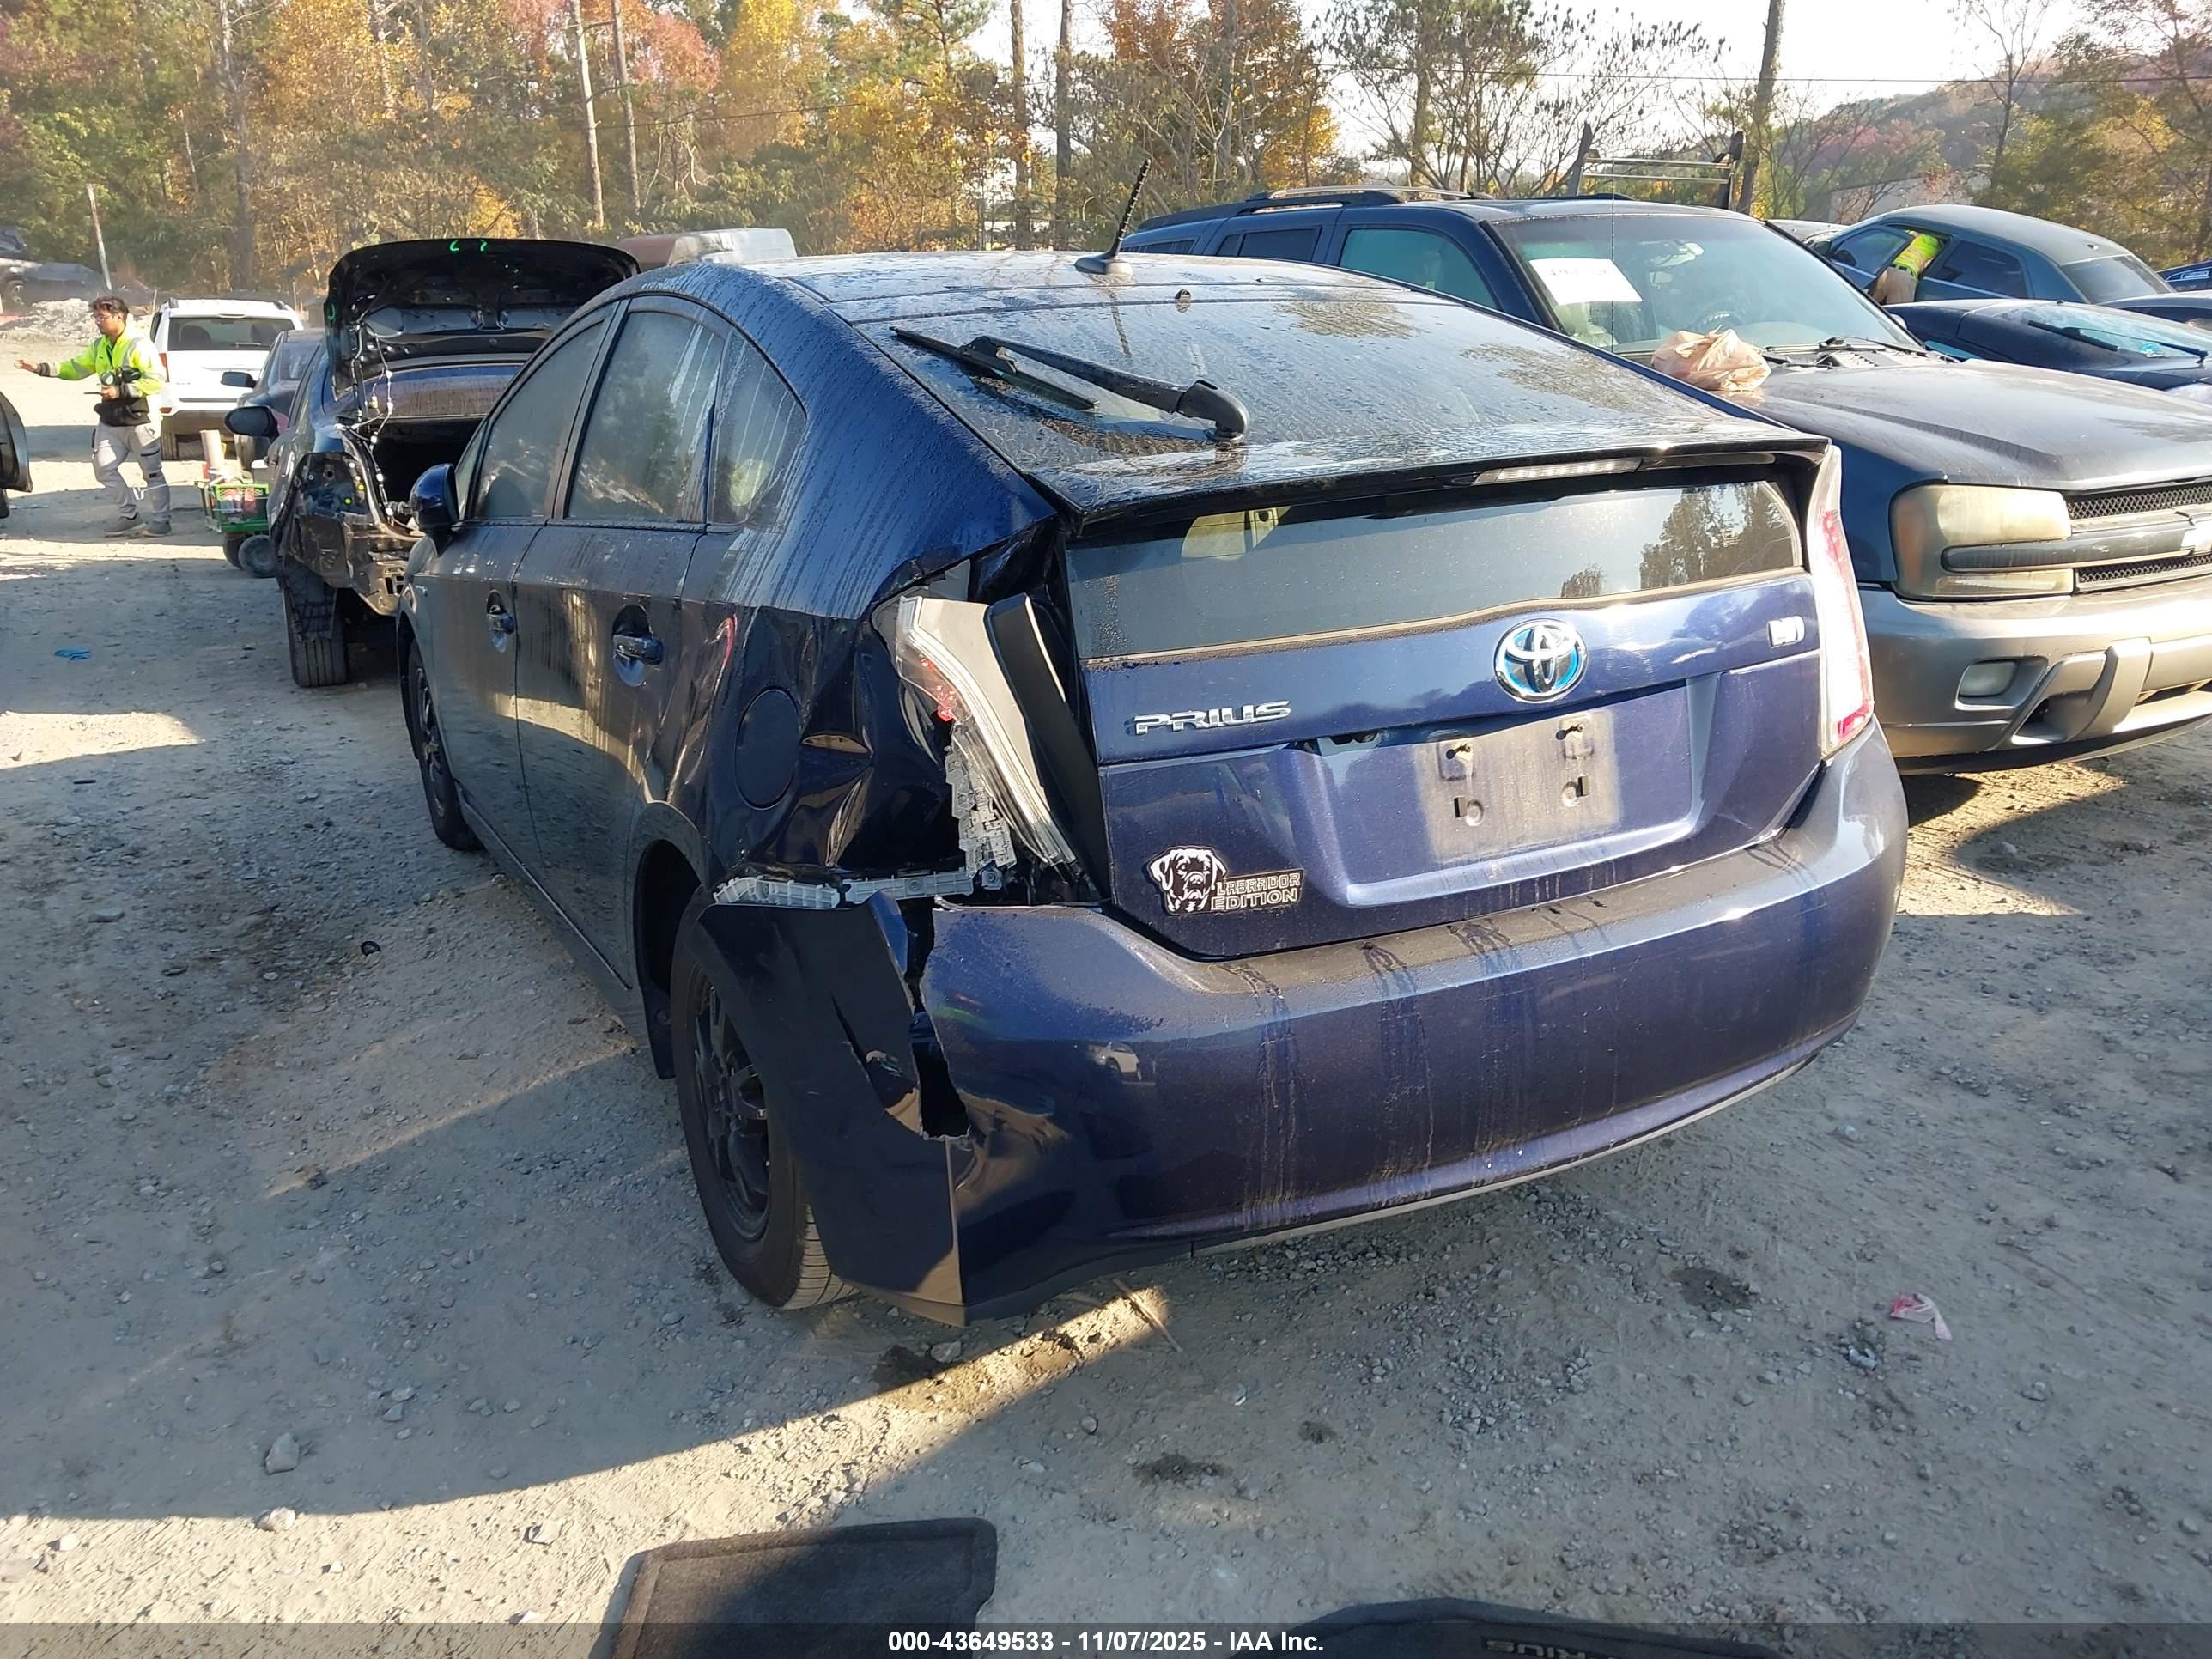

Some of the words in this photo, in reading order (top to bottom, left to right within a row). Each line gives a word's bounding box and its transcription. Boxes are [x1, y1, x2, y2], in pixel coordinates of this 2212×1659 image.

[1133, 699, 1292, 736] PRIUS
[1215, 872, 1302, 896] LABRADOR
[1210, 887, 1299, 911] EDITION
[1486, 1639, 1619, 1659] RIUS
